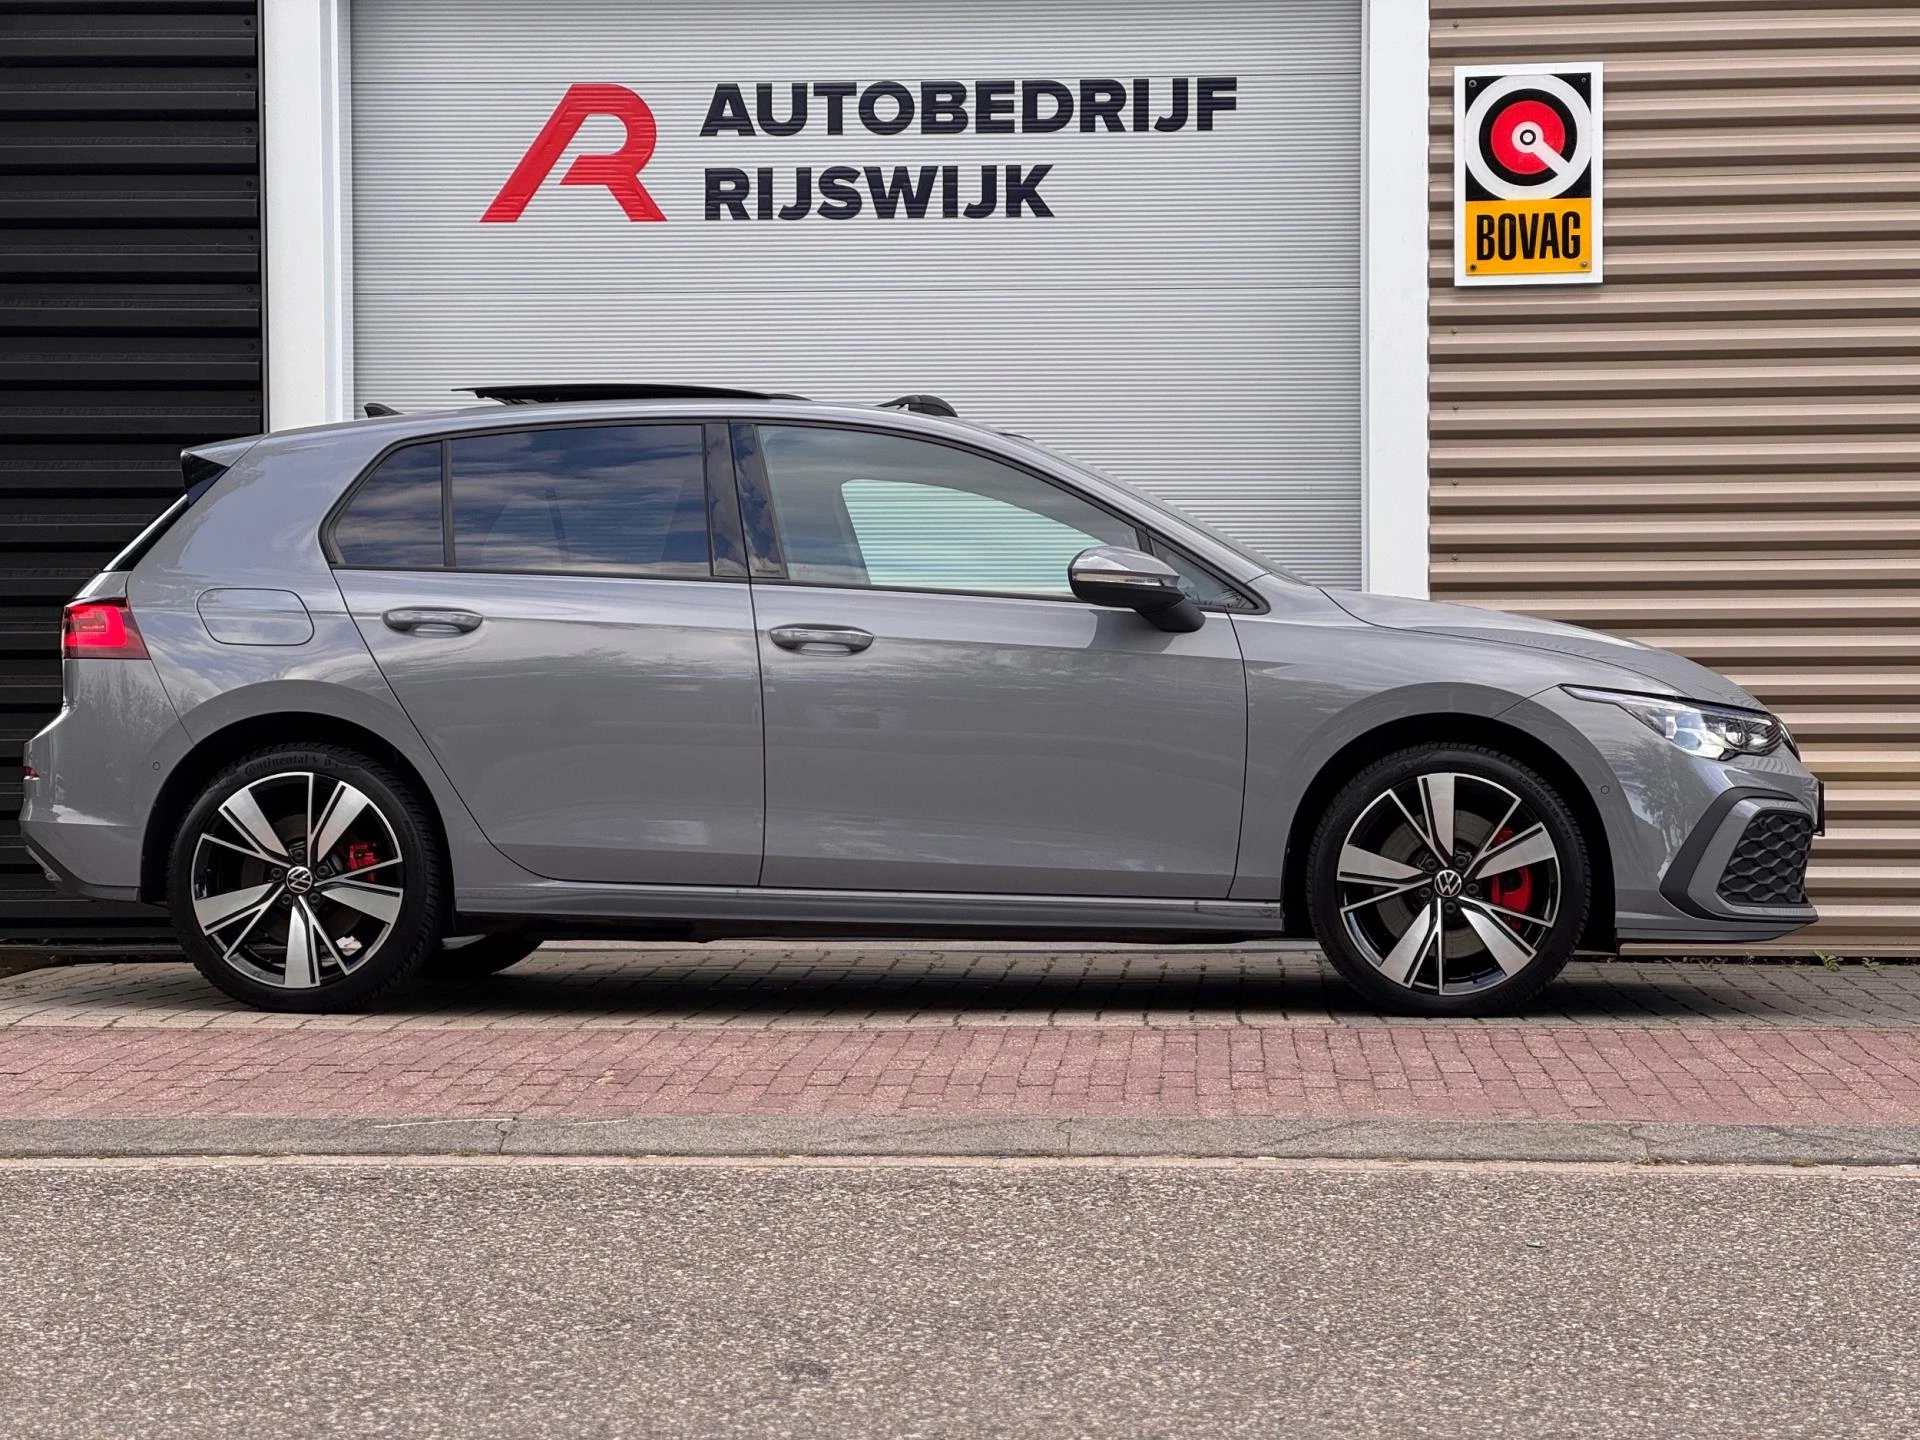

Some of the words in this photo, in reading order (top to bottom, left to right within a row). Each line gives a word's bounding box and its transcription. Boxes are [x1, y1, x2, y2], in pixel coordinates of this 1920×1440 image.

[699, 76, 1238, 137] AUTOBEDRIJF
[703, 164, 1055, 221] RIJSWIJK
[1476, 211, 1581, 261] BOVAG
[244, 754, 309, 776] Continental
